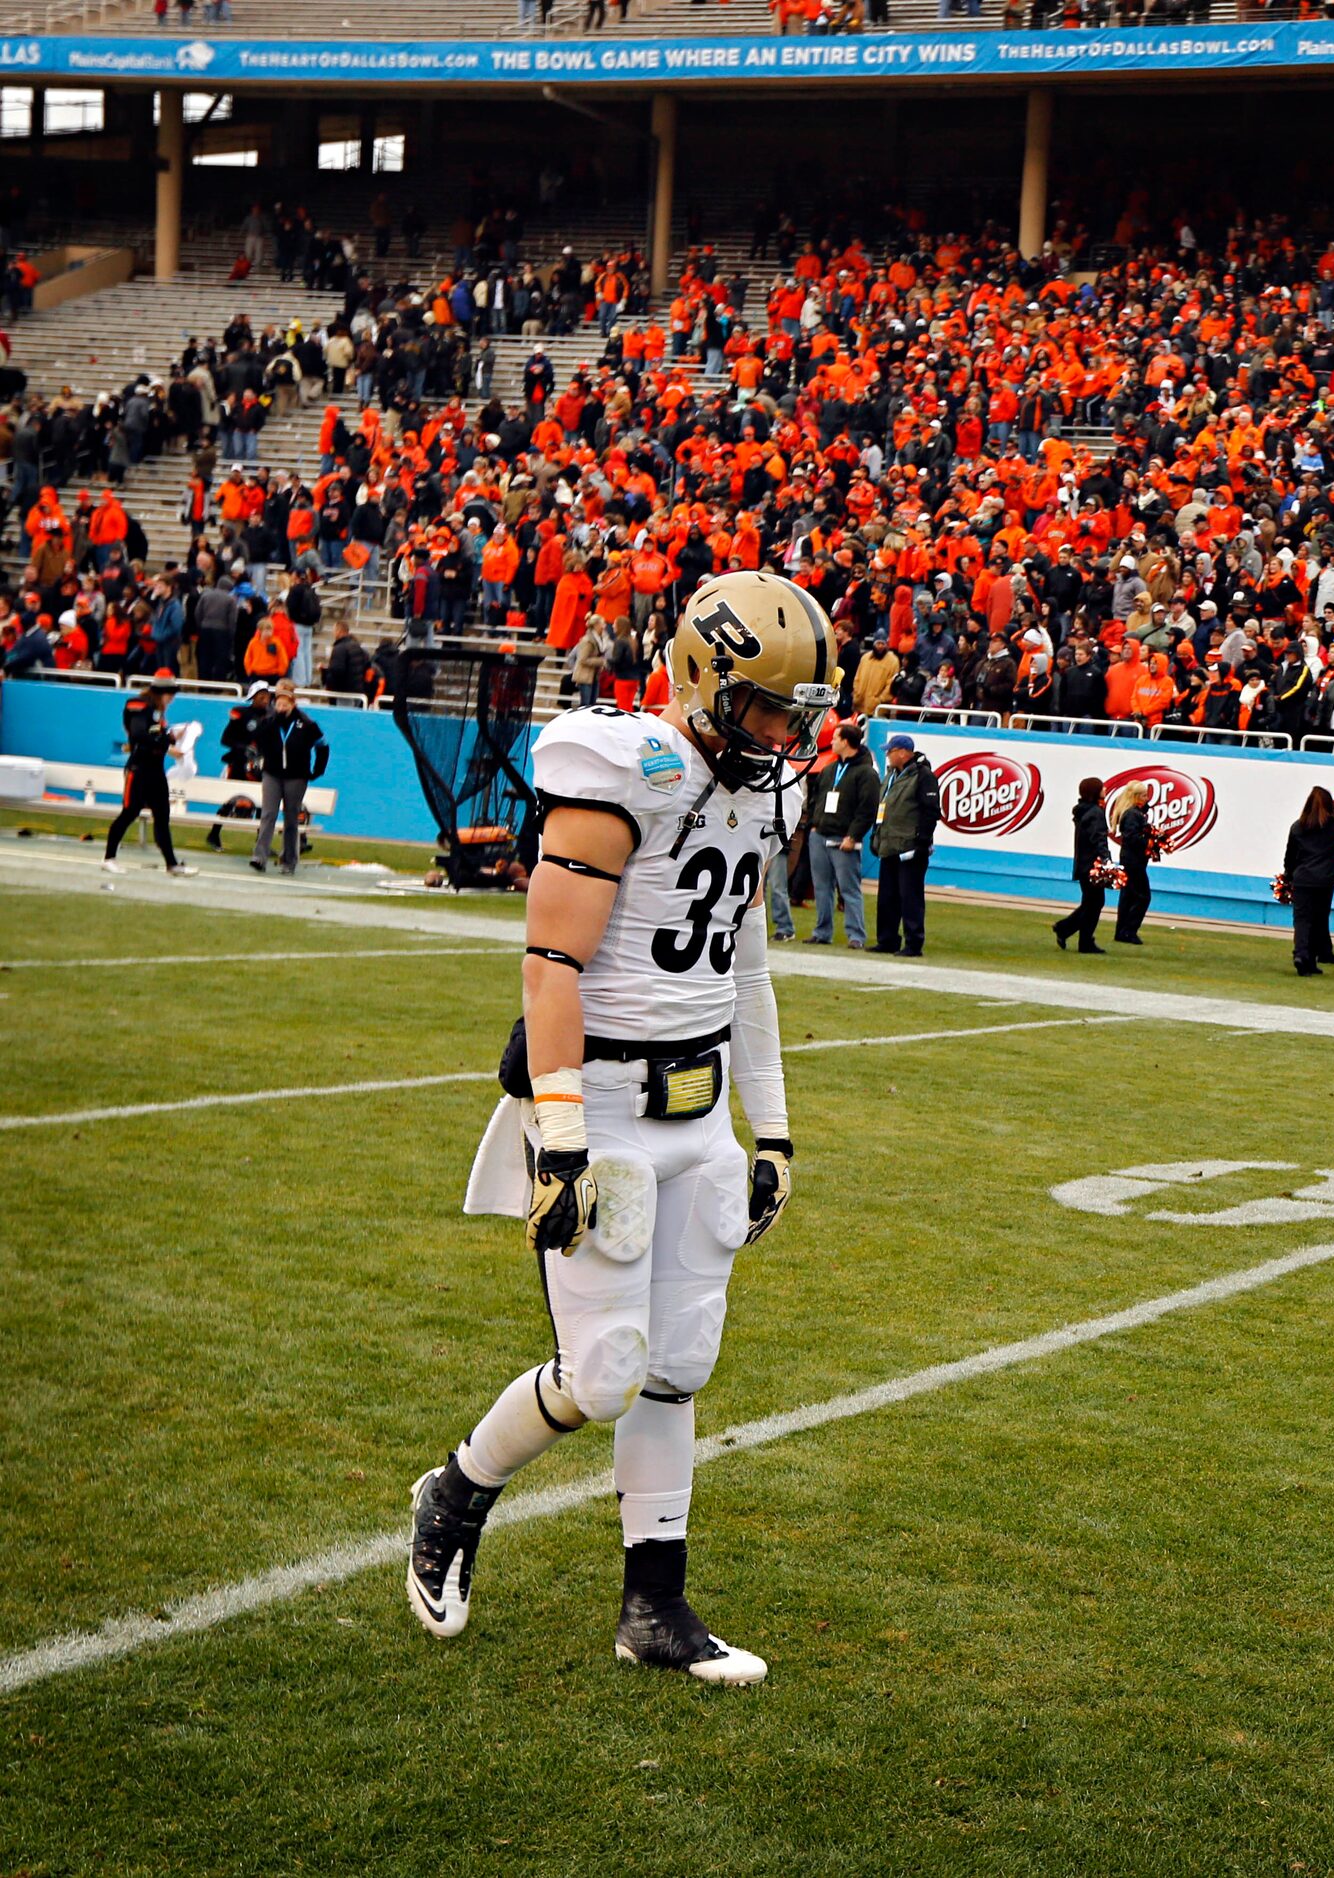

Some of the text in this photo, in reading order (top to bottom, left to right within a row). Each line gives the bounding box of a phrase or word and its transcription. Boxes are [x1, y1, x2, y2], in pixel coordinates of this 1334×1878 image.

[0, 42, 40, 64] LAS
[491, 42, 976, 69] THE BOWL GAME WHERE AN ENTIRE CITY WINS
[690, 599, 763, 660] P
[941, 770, 1022, 823] Pepper
[970, 764, 1003, 797] Dr
[651, 847, 760, 975] 33
